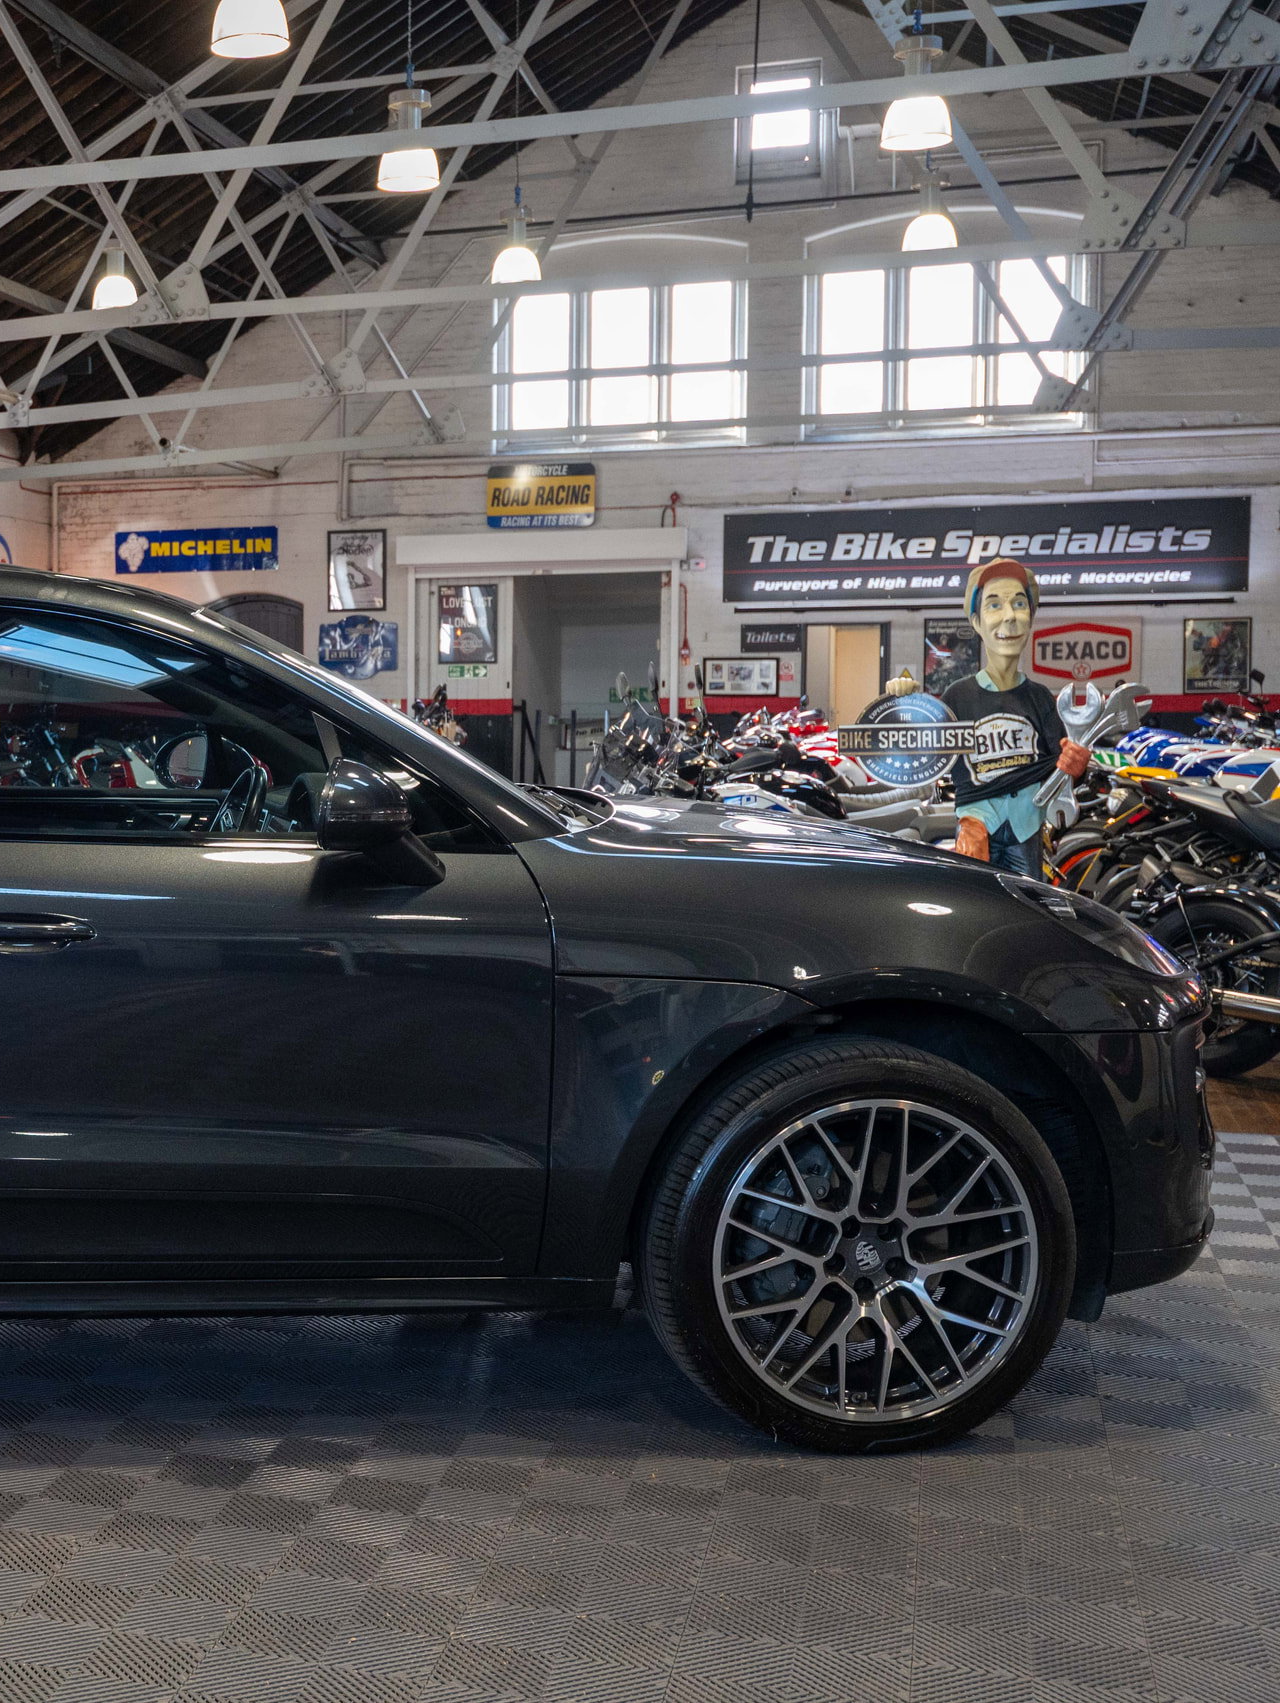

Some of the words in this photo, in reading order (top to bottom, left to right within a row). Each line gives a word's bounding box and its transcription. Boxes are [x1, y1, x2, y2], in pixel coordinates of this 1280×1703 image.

[491, 487, 532, 507] ROAD
[535, 484, 591, 506] RACING
[500, 516, 531, 528] RACING
[531, 516, 543, 527] AT
[544, 515, 557, 527] ITS
[558, 514, 580, 526] BEST
[150, 538, 272, 557] MICHELIN
[746, 535, 827, 564] The
[830, 531, 937, 562] Bike
[941, 524, 1212, 565] Specialists
[753, 578, 838, 592] Purveyors
[842, 577, 862, 590] of
[867, 576, 907, 590] High
[910, 575, 944, 588] End
[947, 574, 962, 587] &
[1078, 570, 1192, 585] Motorcycles
[745, 631, 797, 644] Toilets
[1037, 640, 1127, 661] TEXACO
[900, 713, 912, 721] THE
[839, 731, 872, 749] BIKE
[878, 729, 974, 749] SPECIALISTS
[975, 729, 1024, 755] BIKE
[866, 758, 908, 781] SHEFFIELD
[913, 757, 947, 781] ENGLAND
